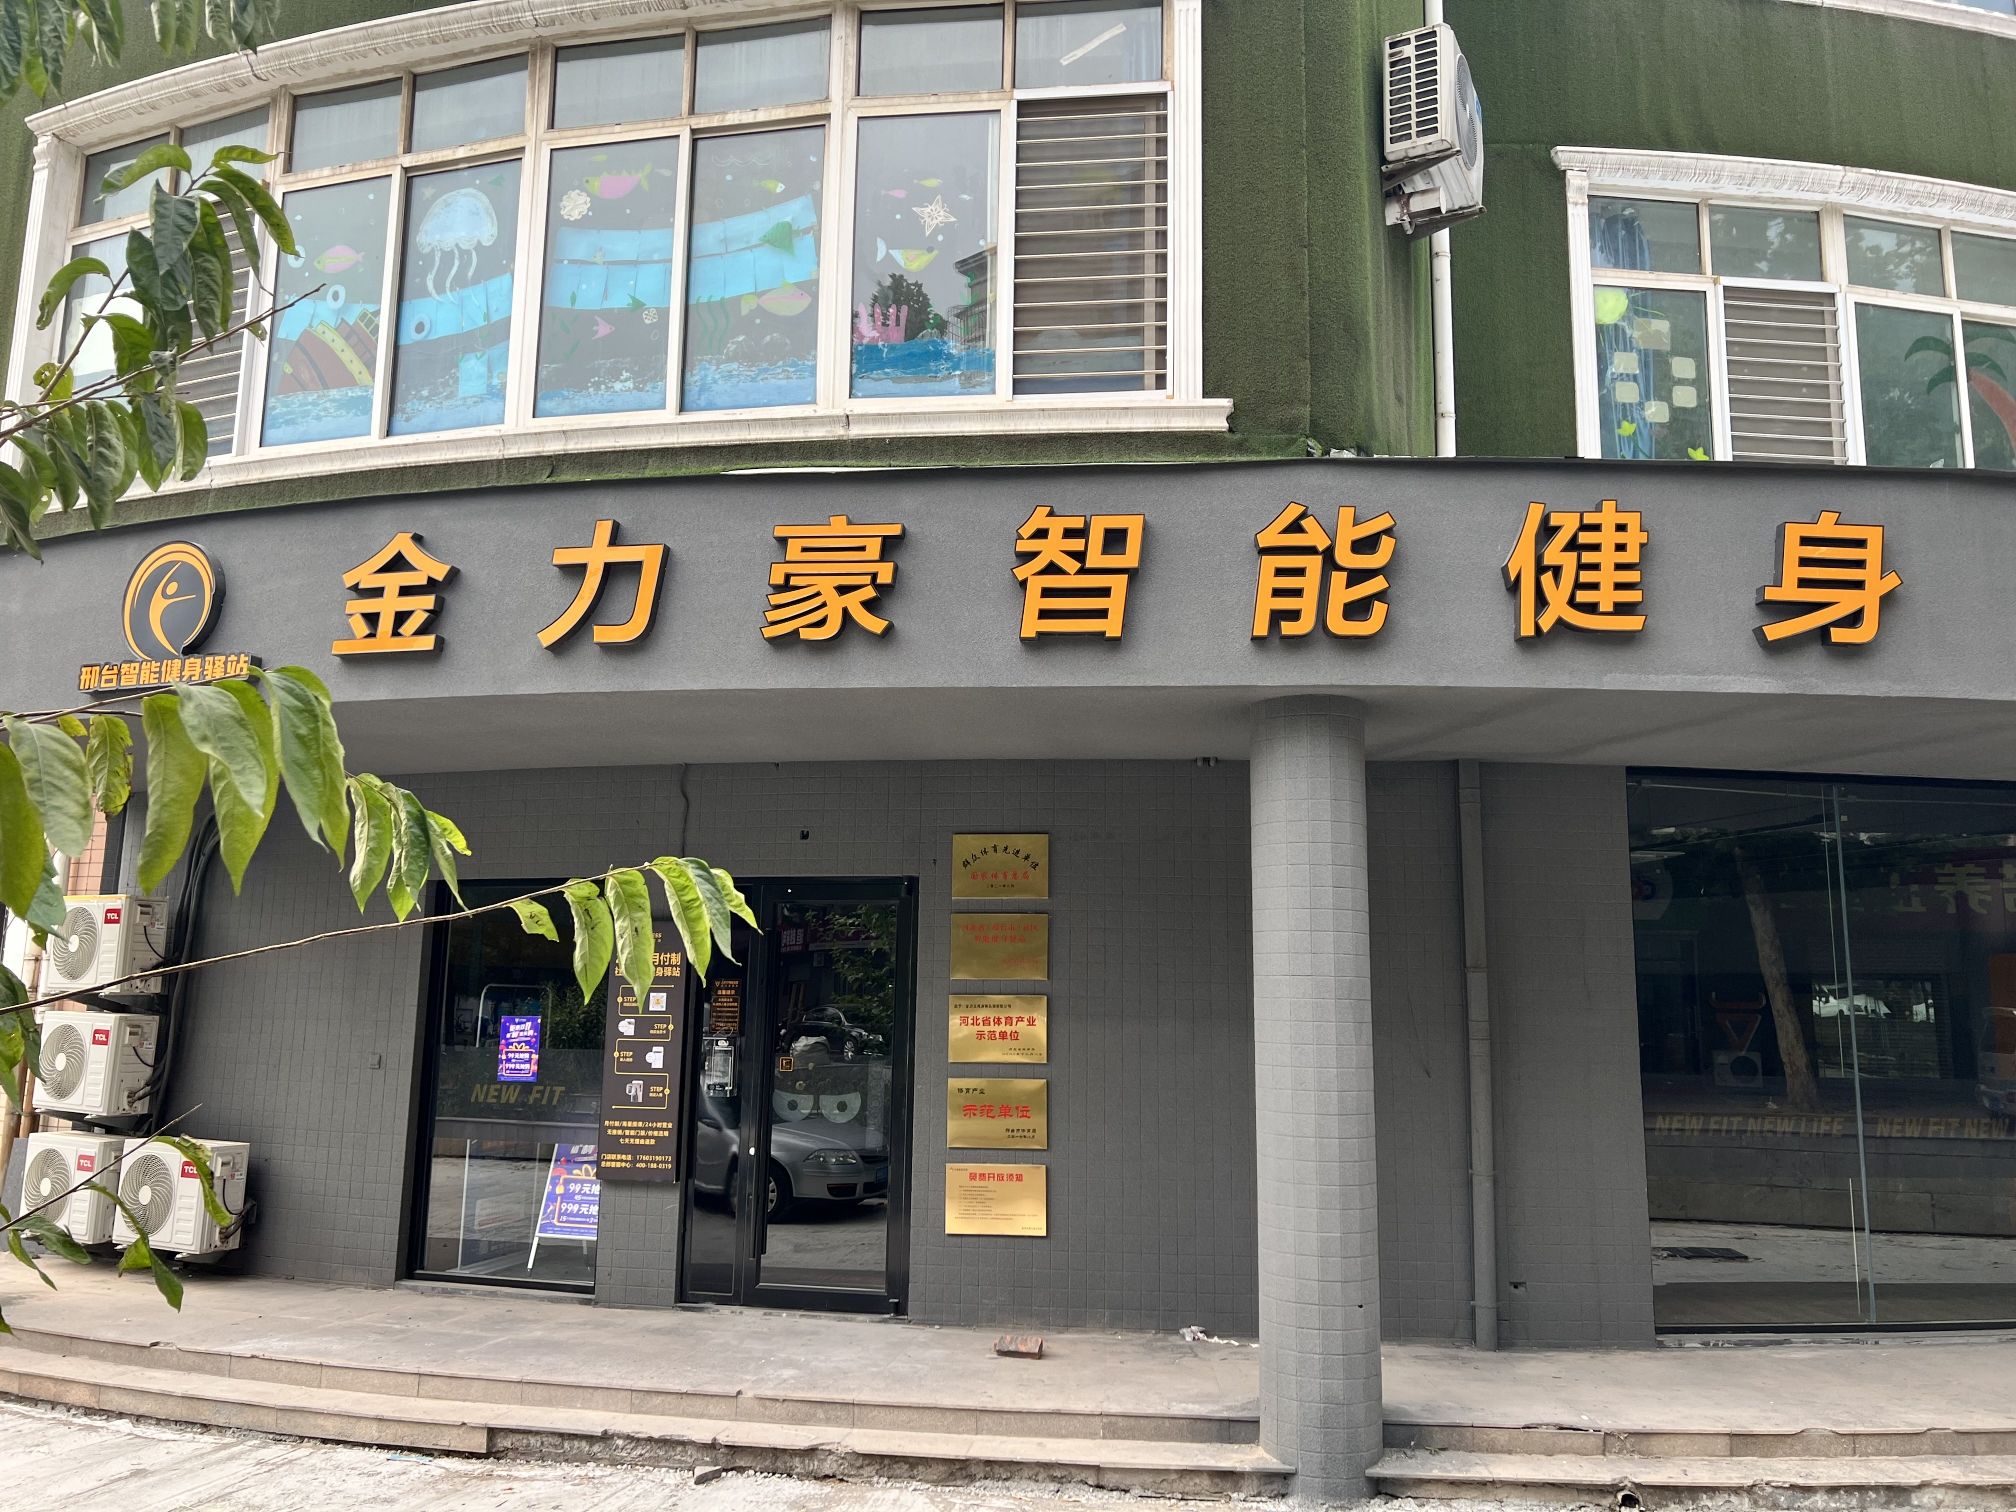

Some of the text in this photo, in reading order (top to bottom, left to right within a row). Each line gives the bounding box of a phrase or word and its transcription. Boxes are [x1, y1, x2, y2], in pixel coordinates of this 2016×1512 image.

[331, 498, 1904, 657] 金力豪智能健身
[79, 653, 250, 690] 邢台智能健身驿站
[961, 843, 1040, 871] 群众体育先进单位
[106, 912, 119, 920] TCL
[959, 1015, 1037, 1027] 河北省体育产业
[94, 1033, 107, 1041] TCL
[975, 1029, 1020, 1041] 示范单位
[470, 1083, 566, 1105] NEW FIT
[961, 1103, 1032, 1120] 示范单位
[1653, 1115, 1845, 1137] NEW FIT NEW LIFE
[1876, 1117, 2011, 1139] NEW FIT NEW
[79, 1159, 92, 1167] TCL
[968, 1172, 1024, 1182] 免费开放须知
